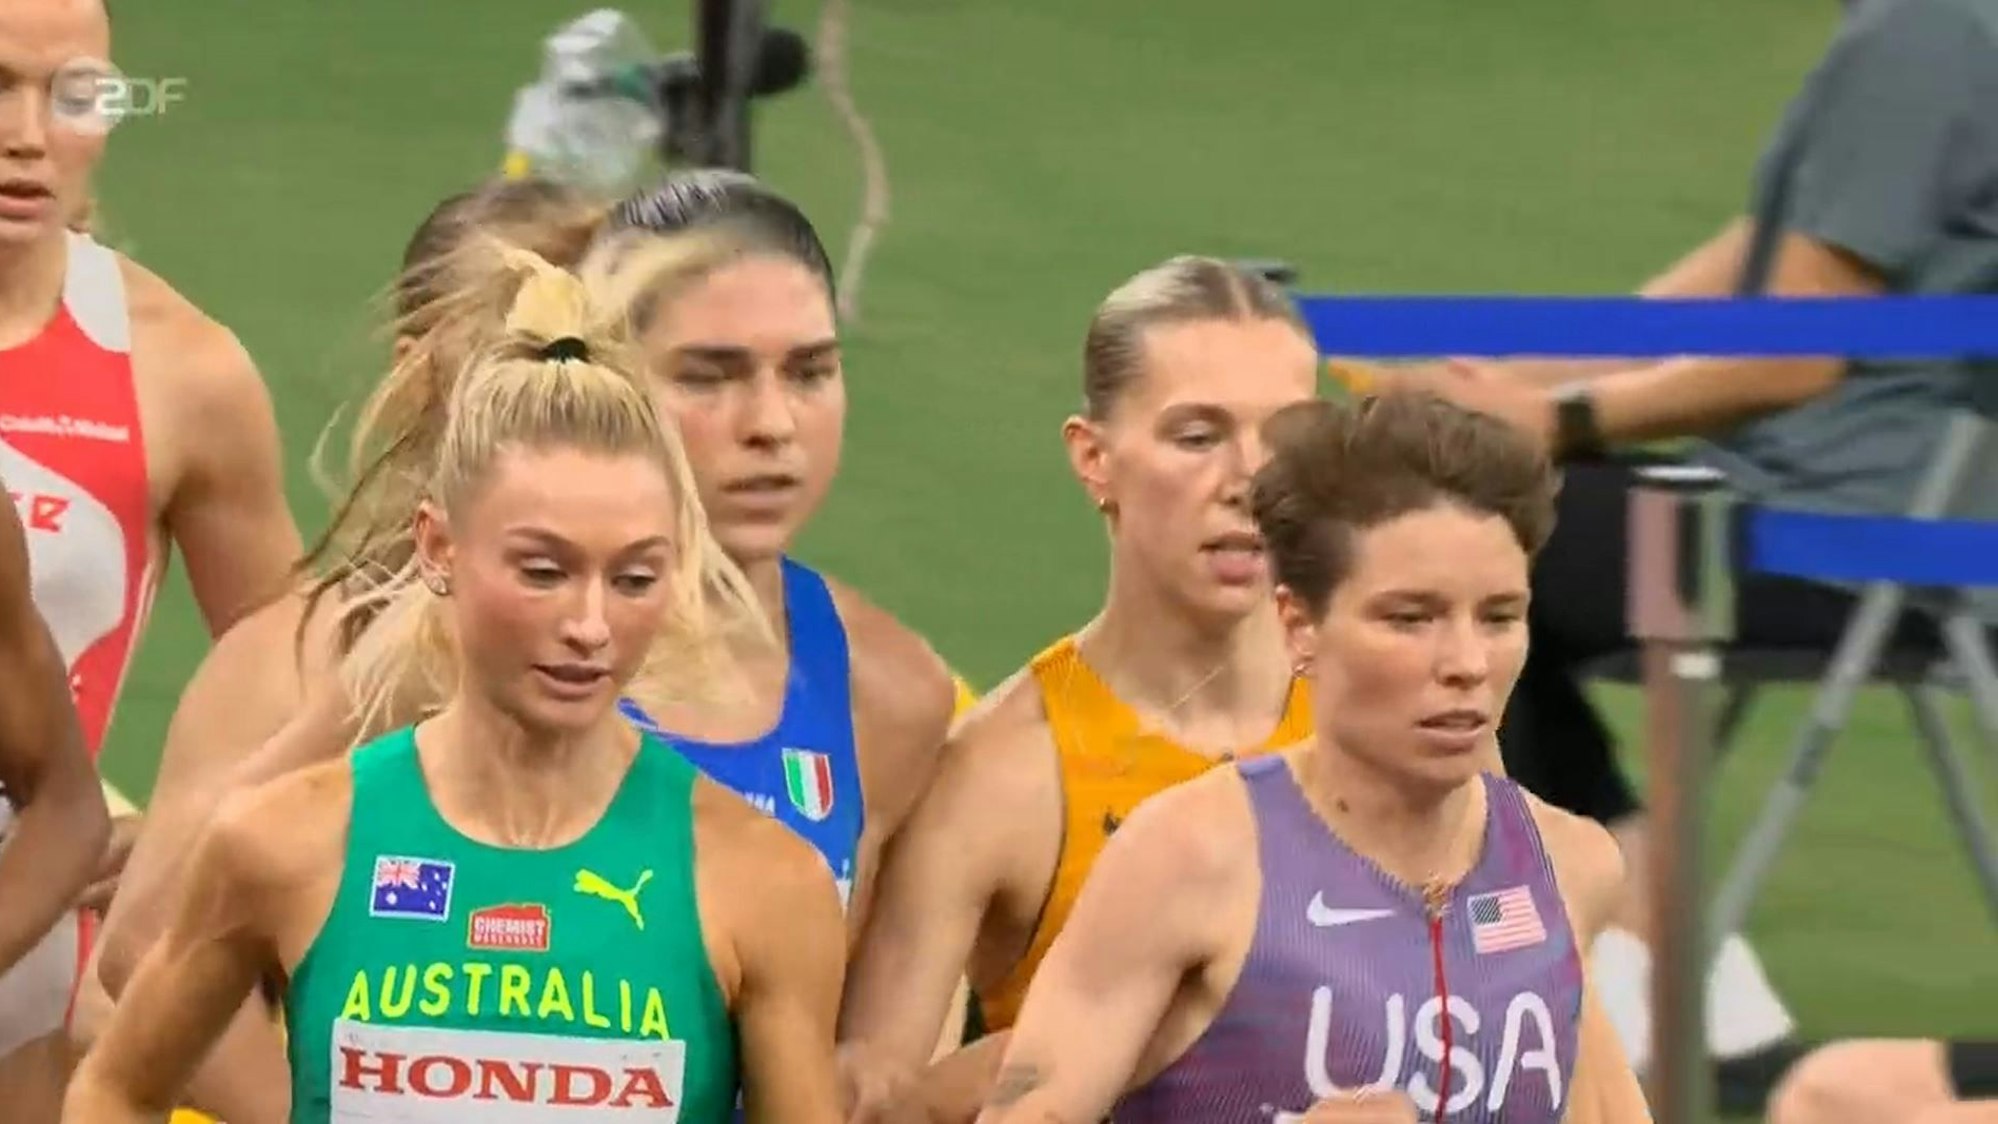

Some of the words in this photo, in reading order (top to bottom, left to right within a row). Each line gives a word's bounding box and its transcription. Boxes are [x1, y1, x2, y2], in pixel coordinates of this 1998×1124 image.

[474, 916, 546, 936] CHEMIST
[341, 962, 671, 1041] AUSTRALIA
[338, 1046, 674, 1108] HONDA
[1305, 985, 1562, 1114] USA
